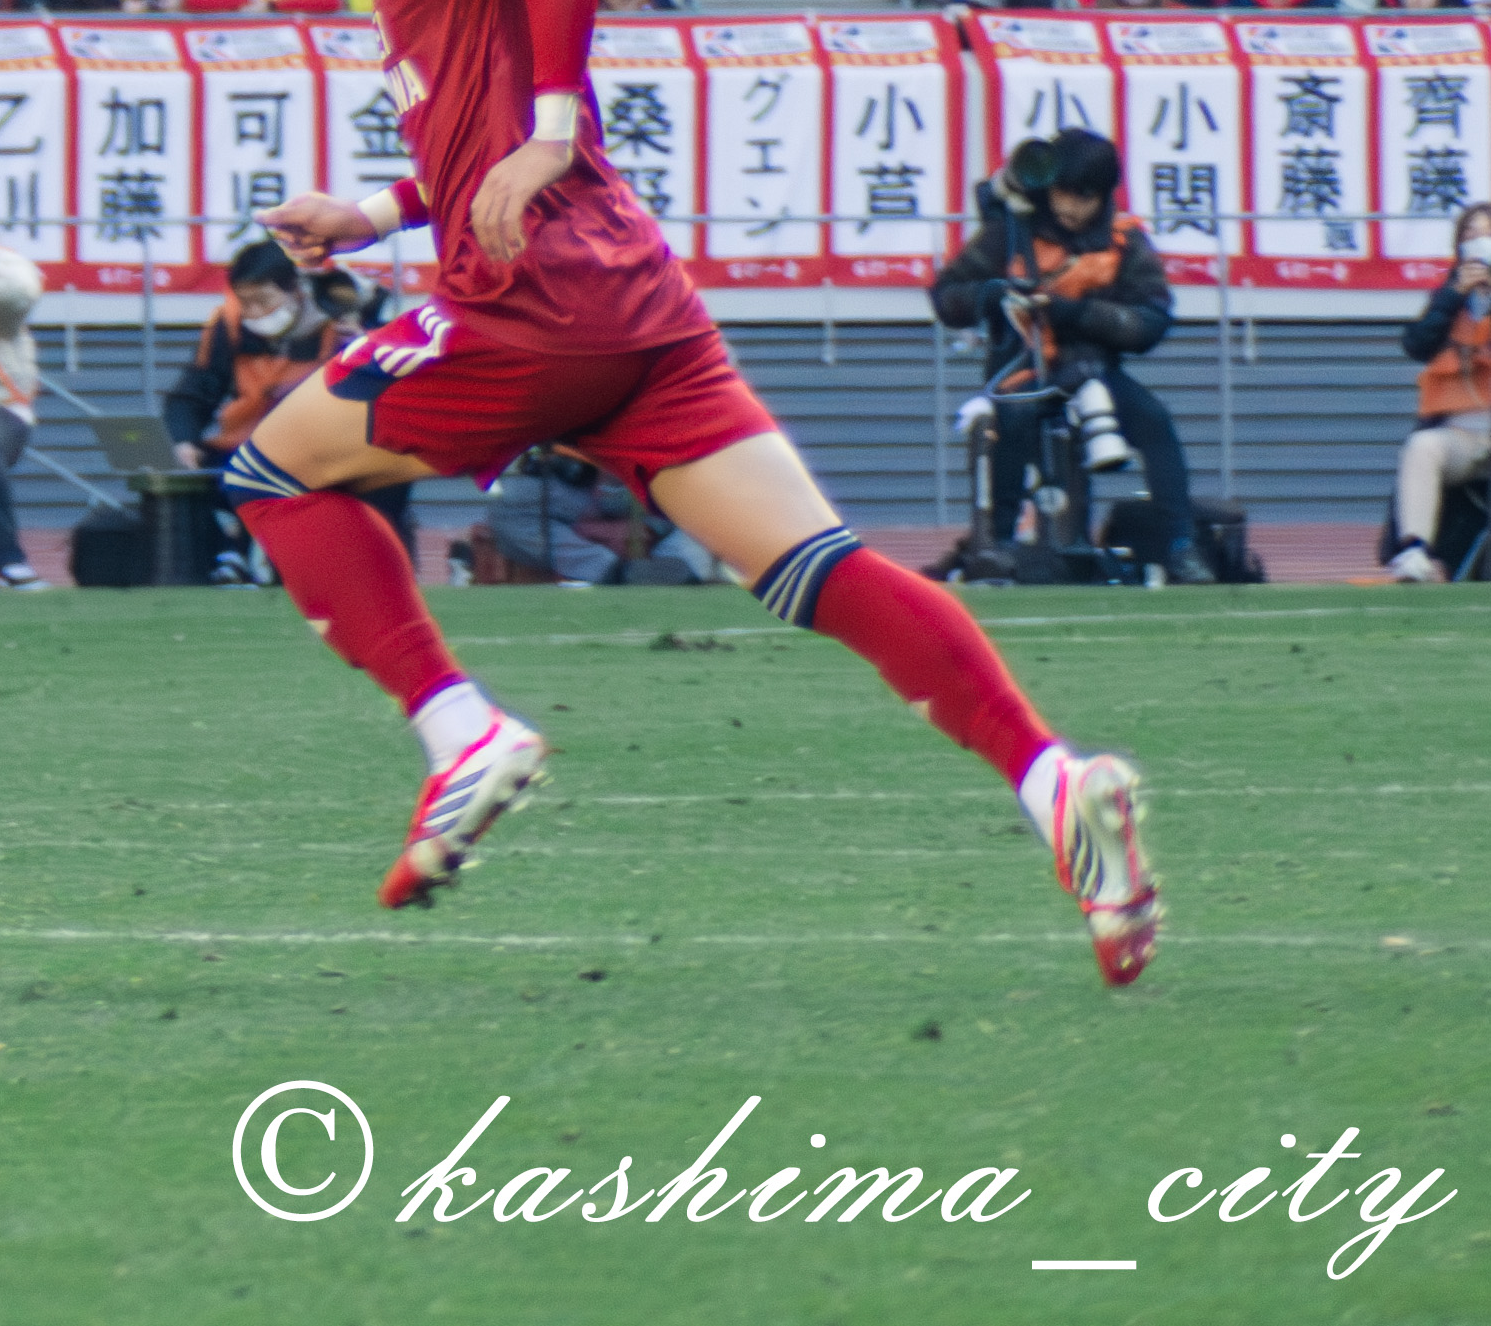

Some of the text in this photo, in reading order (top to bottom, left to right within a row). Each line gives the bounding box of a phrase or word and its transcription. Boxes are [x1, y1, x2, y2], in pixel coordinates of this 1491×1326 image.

[98, 89, 167, 245] 加藤
[350, 87, 412, 185] 金
[740, 73, 790, 237] グエン
[1149, 82, 1219, 237] 小関
